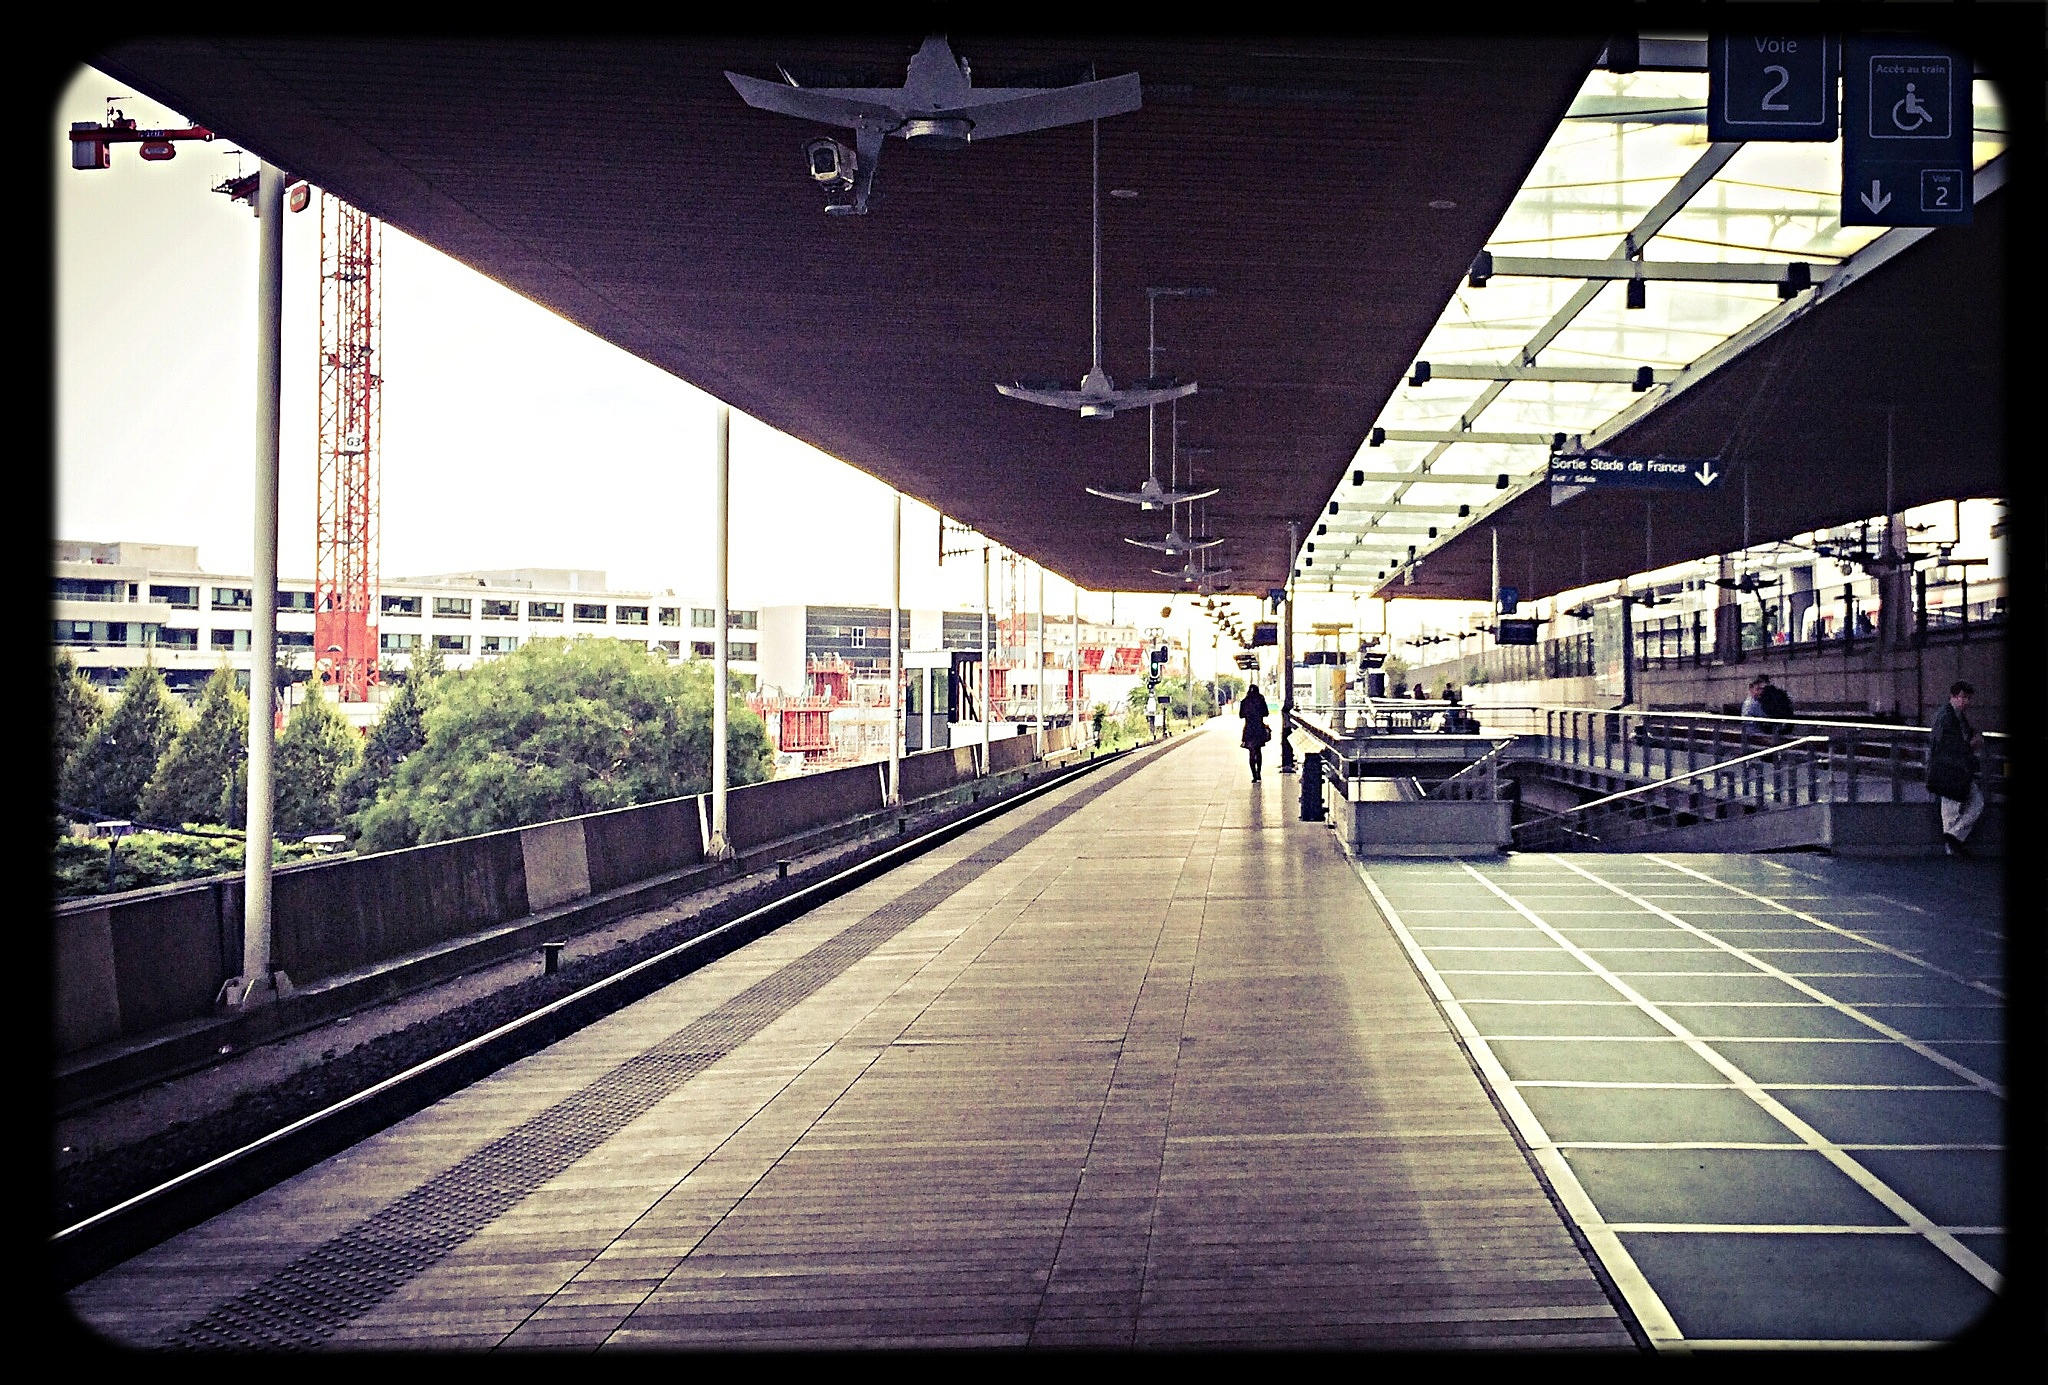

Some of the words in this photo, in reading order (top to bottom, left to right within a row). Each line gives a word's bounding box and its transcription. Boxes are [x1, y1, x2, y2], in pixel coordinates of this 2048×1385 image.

[1755, 36, 1798, 54] Voie
[1876, 64, 1905, 74] Accès
[1906, 66, 1920, 74] au
[1921, 65, 1946, 74] train
[1761, 65, 1790, 111] 2
[1935, 186, 1949, 206] 2
[346, 437, 360, 447] G3
[1551, 457, 1588, 470] Sortie
[1590, 458, 1624, 471] Stade
[1627, 460, 1644, 472] de
[1647, 460, 1687, 473] France
